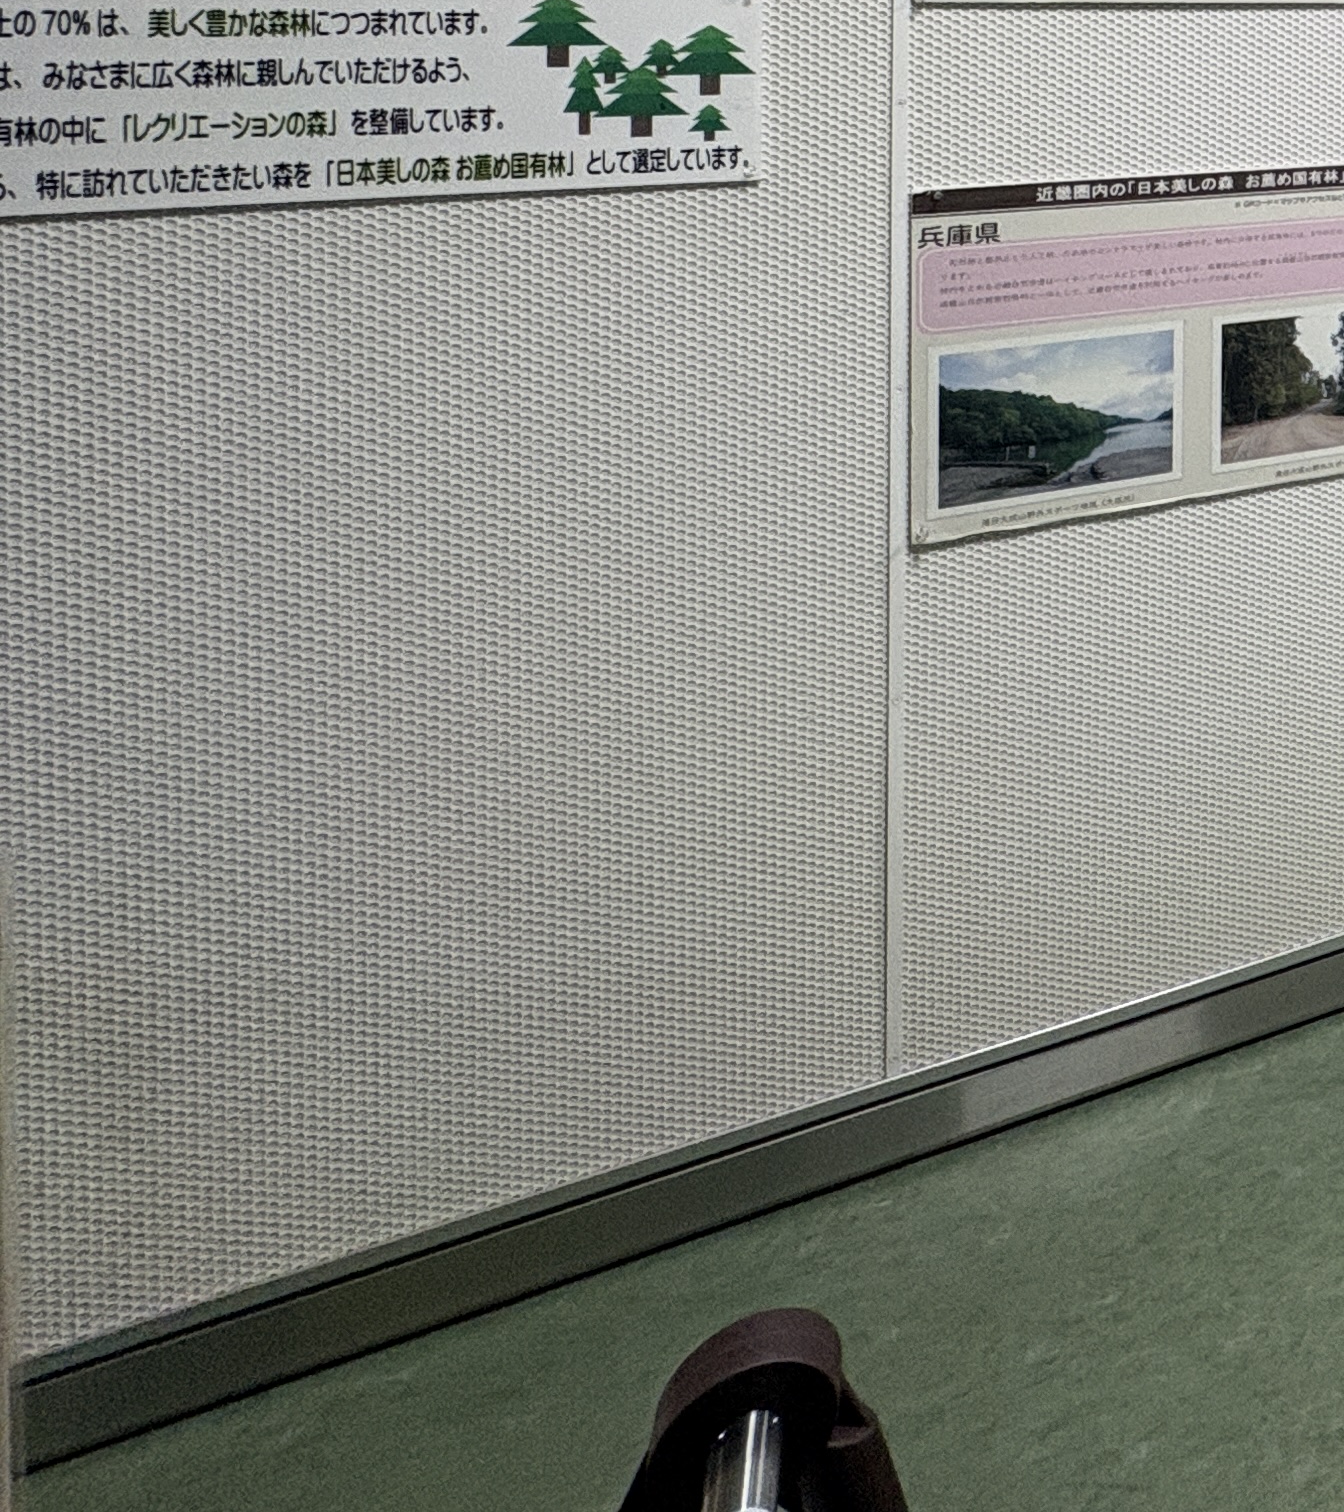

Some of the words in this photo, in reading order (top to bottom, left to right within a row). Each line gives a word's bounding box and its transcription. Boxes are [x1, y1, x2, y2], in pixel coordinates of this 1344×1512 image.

[1036, 175, 1234, 204] 近畿圏内の「日本美しの森
[917, 222, 1001, 249] 兵庫県
